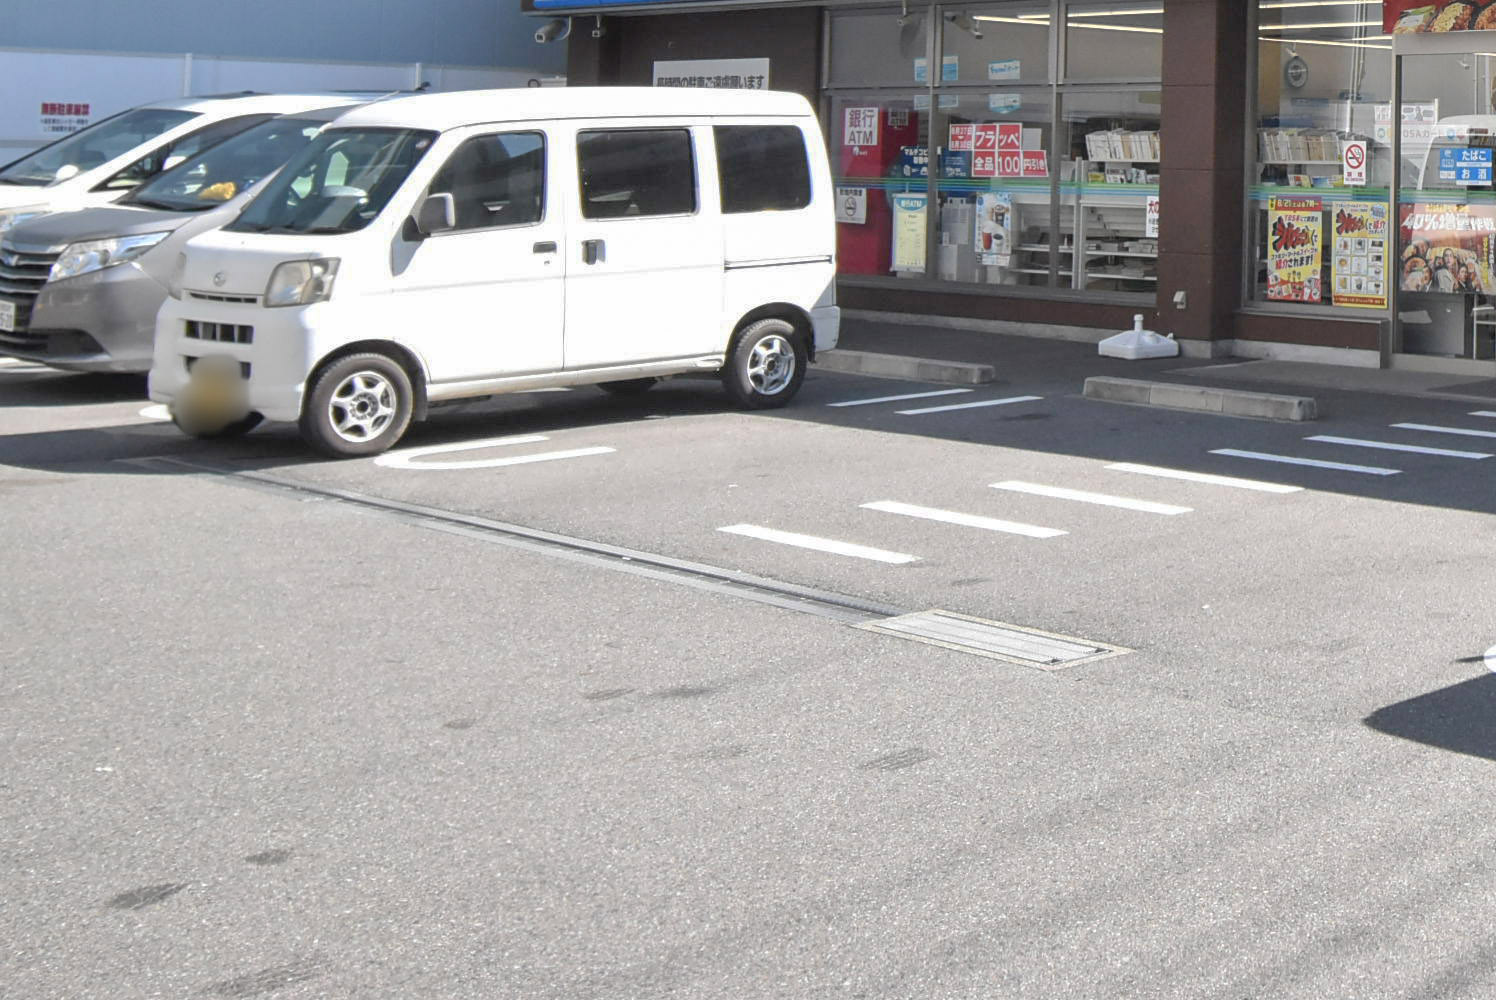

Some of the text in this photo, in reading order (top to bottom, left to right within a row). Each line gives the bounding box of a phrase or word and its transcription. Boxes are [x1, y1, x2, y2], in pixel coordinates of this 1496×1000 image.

[848, 109, 875, 128] 銀行
[848, 130, 873, 144] ATM
[976, 130, 1019, 147] フラッペ
[1461, 150, 1487, 161] たばこ
